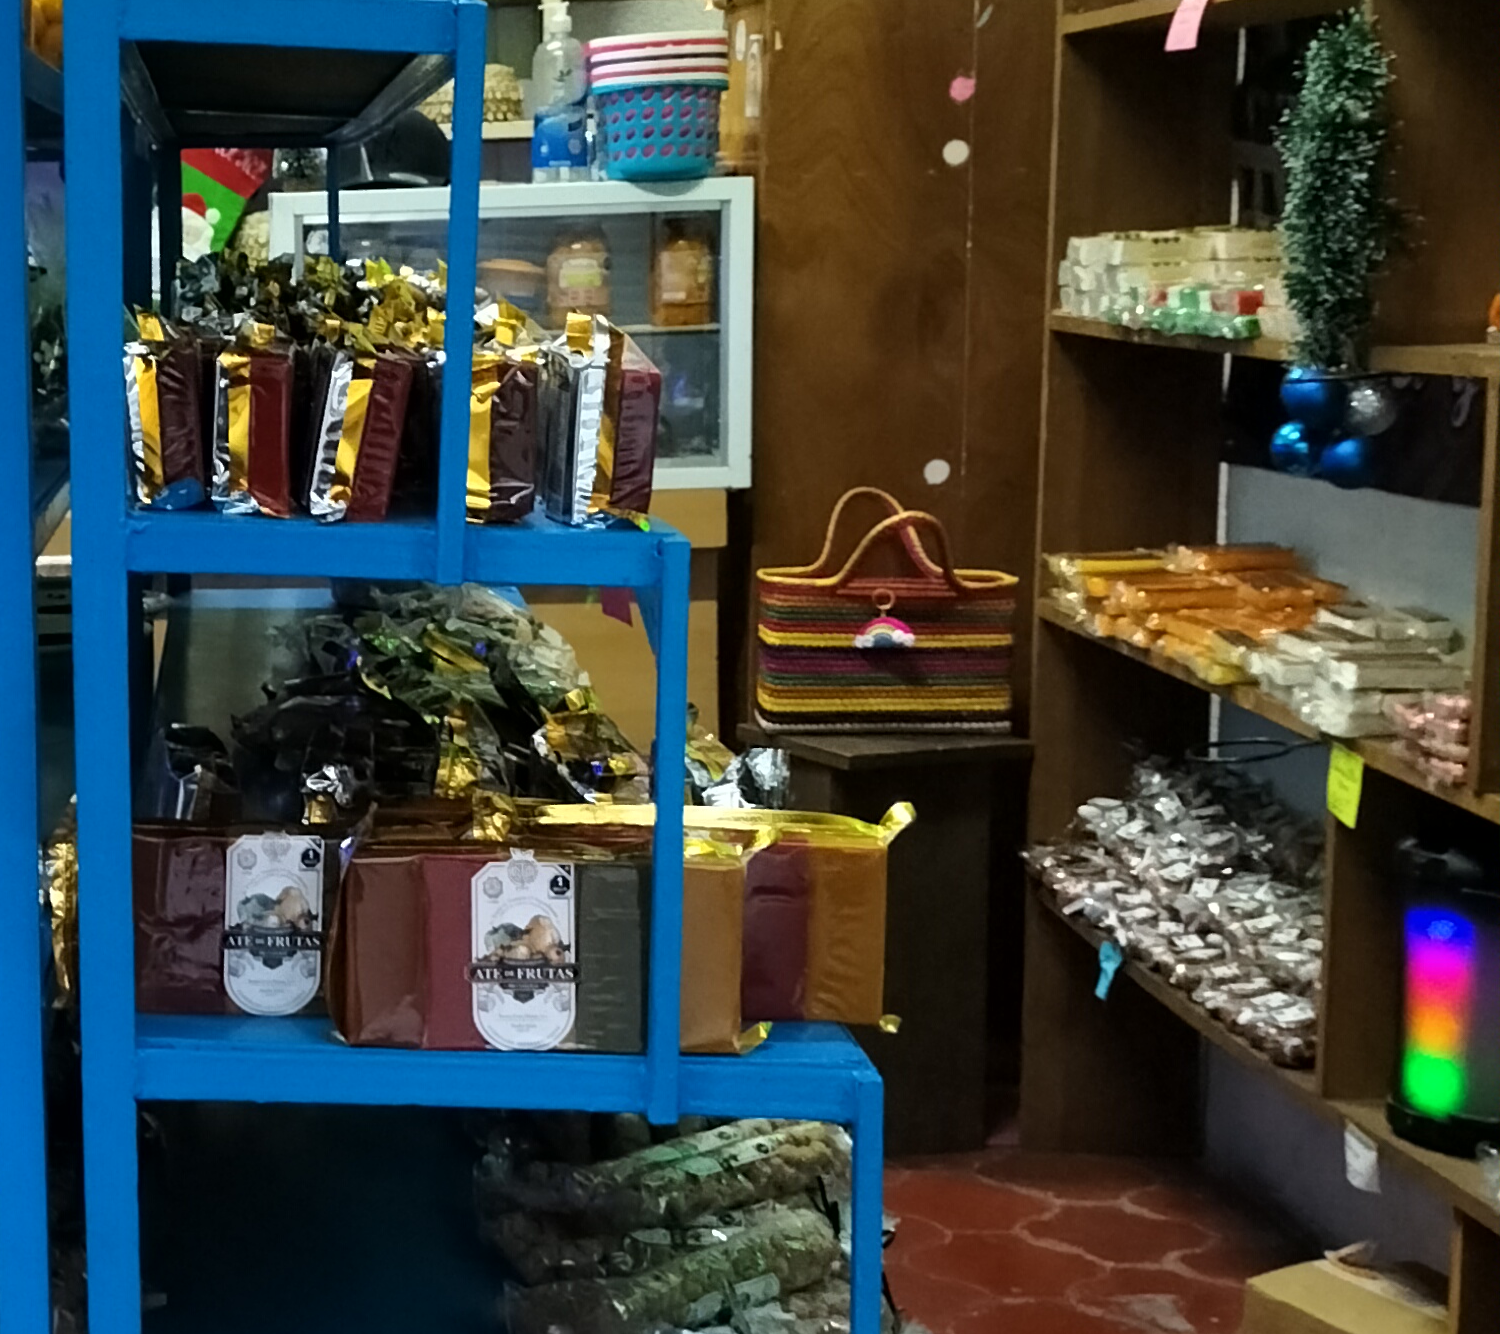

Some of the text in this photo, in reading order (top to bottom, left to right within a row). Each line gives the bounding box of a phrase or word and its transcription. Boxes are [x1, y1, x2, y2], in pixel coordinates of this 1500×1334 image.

[227, 936, 253, 946] ATE
[267, 936, 321, 947] FRUTAS
[474, 968, 503, 979] ATE
[517, 968, 574, 979] FRUTAS
